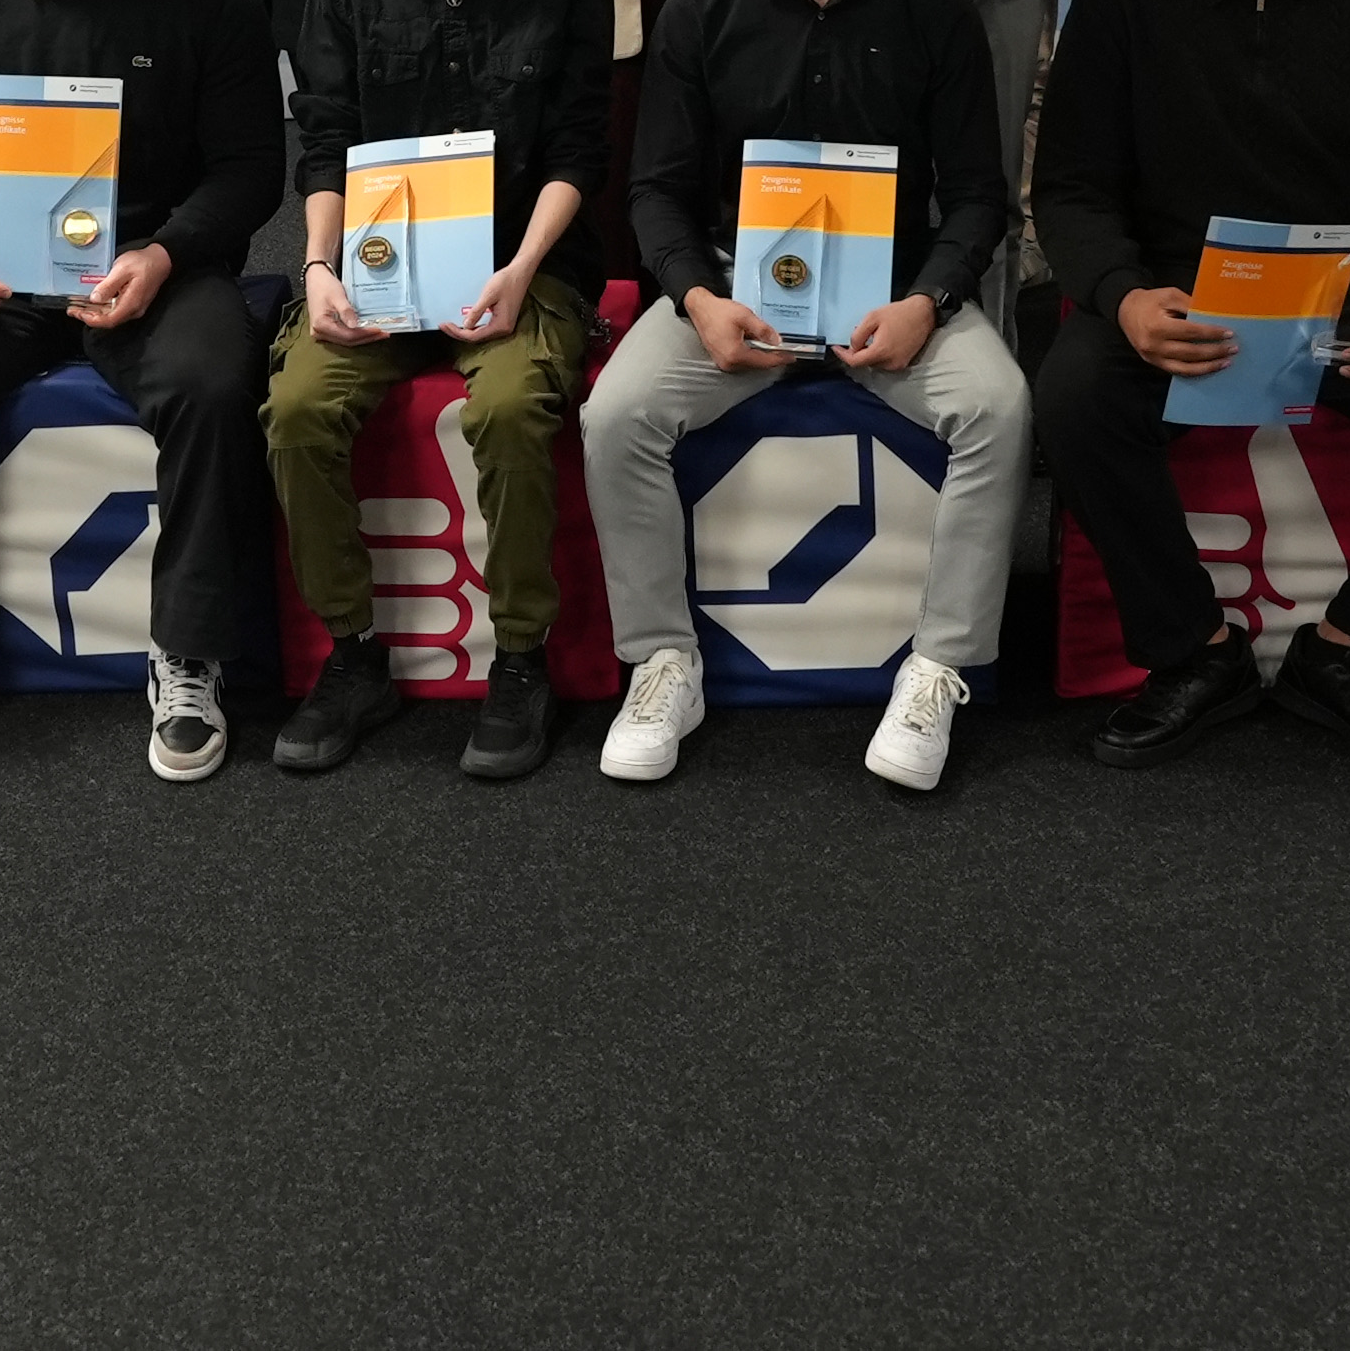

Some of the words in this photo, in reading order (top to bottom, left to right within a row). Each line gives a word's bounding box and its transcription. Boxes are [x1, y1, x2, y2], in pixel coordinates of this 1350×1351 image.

[364, 174, 402, 186] Zeugnisse
[761, 175, 801, 186] Zeugnisse
[761, 185, 802, 194] Zertifikate
